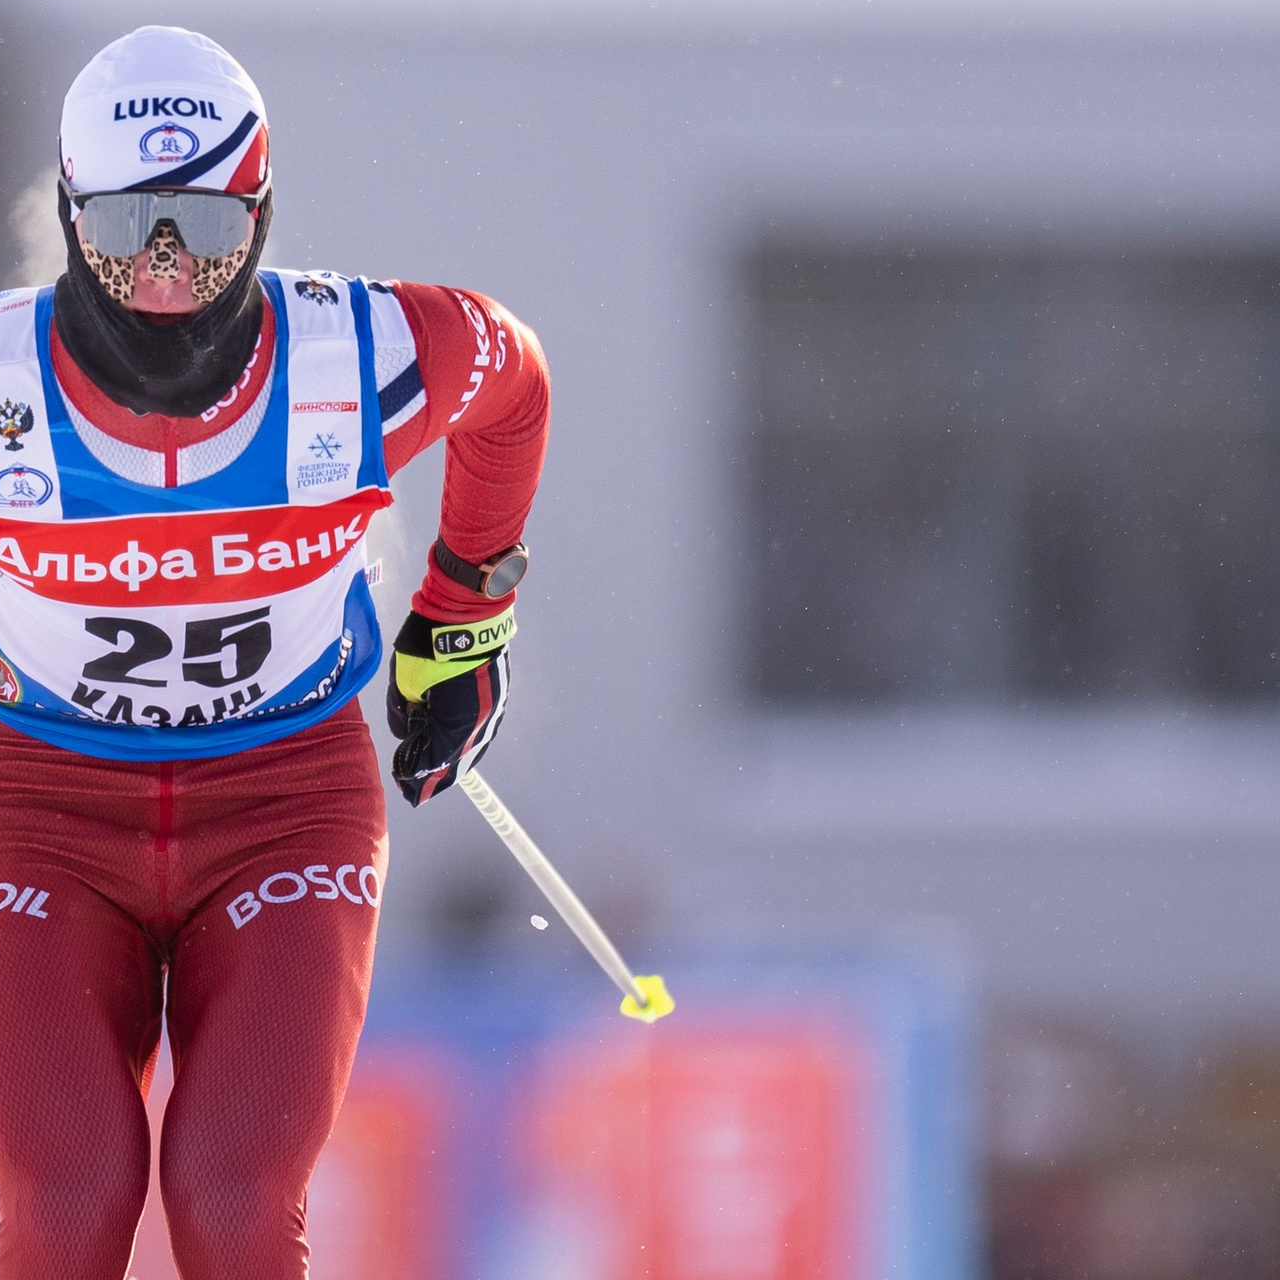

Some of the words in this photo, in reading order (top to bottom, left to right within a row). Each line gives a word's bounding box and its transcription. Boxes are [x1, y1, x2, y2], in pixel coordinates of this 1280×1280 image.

[114, 97, 222, 121] LUKOIL
[448, 292, 490, 424] LUKO
[293, 403, 357, 413] МИНСПОРТ
[211, 513, 363, 576] Банк
[82, 606, 273, 688] 25
[226, 864, 380, 930] BOSCO
